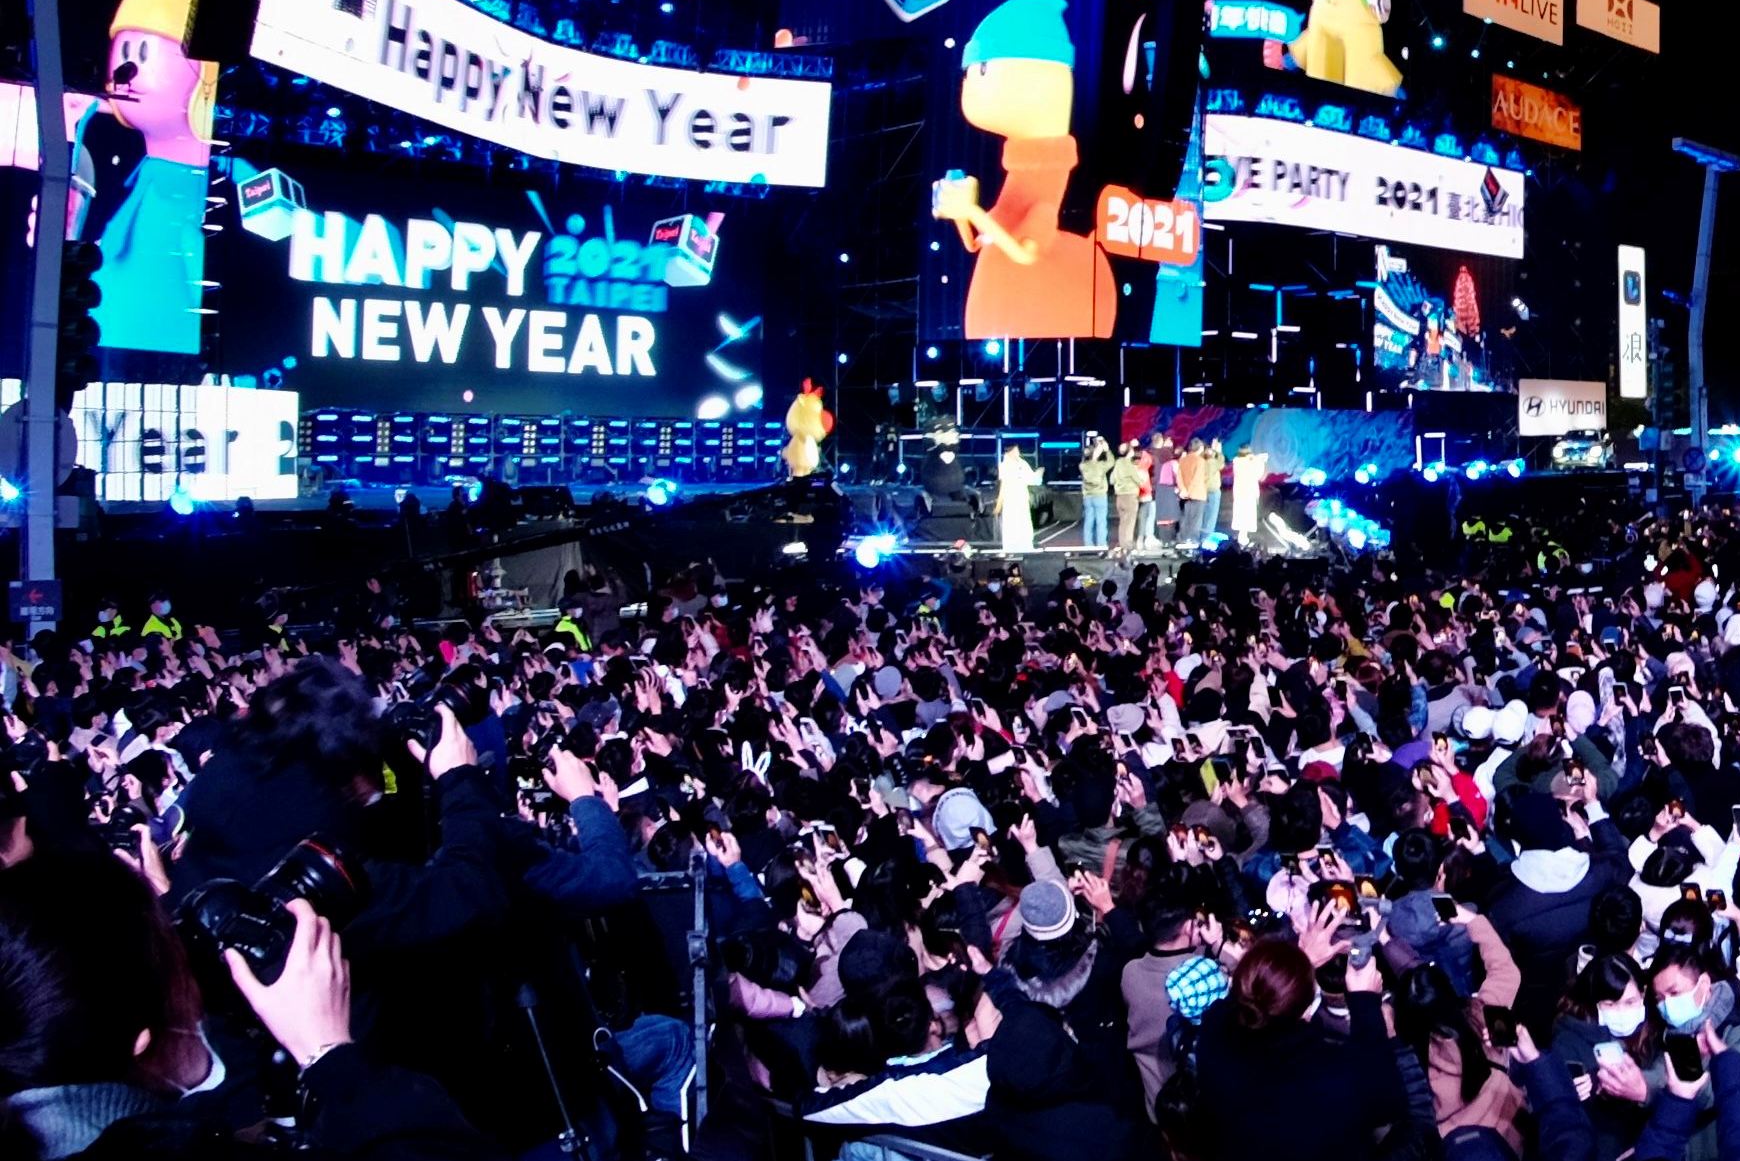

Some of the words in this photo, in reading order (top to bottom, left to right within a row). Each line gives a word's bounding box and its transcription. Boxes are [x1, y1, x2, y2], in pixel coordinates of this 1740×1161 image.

[516, 61, 626, 139] New
[645, 88, 794, 154] Year
[1493, 89, 1580, 136] AUDACE
[1272, 159, 1350, 201] PARTY
[1376, 176, 1439, 215] 2021
[289, 208, 542, 297] HAPPY
[1106, 196, 1194, 254] 2021
[545, 277, 668, 312] TAIPEI
[311, 296, 471, 364] NEW
[482, 306, 657, 377] YEAR
[1550, 400, 1605, 416] HYUNDAI
[86, 411, 240, 474] Year
